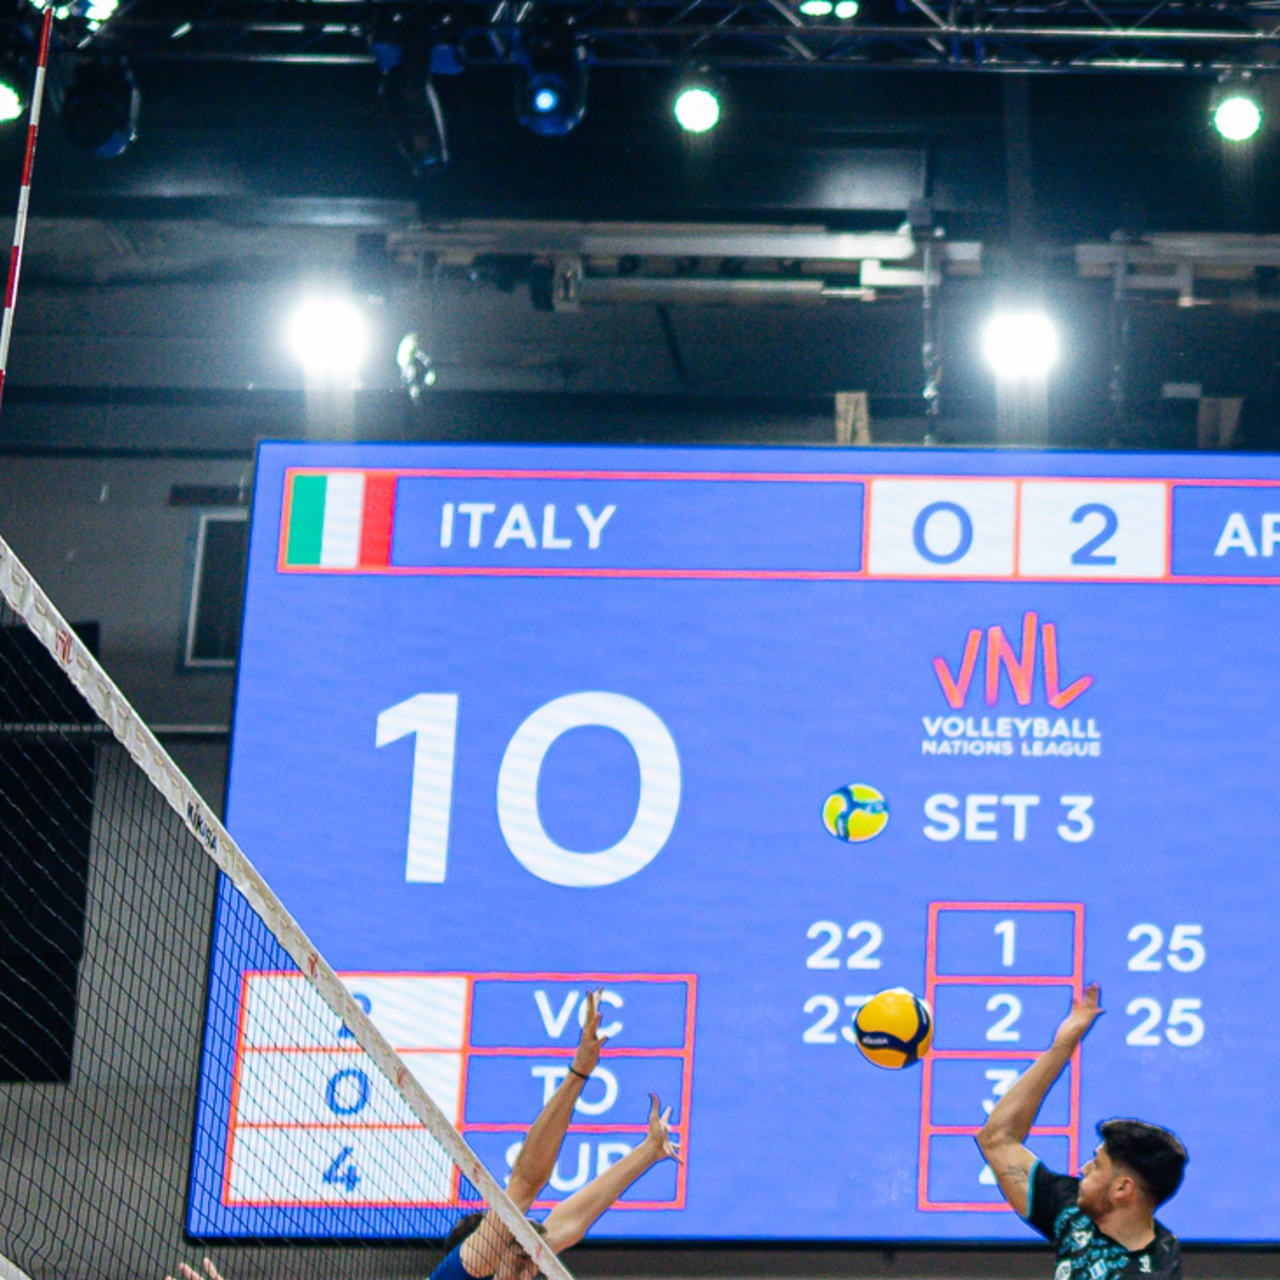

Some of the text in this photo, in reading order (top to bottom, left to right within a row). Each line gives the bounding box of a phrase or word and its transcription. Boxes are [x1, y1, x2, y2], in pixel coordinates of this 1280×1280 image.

[439, 502, 617, 551] ITALY
[911, 501, 975, 565] 0
[1069, 502, 1120, 567] 2
[932, 610, 1095, 710] VNL
[921, 716, 1102, 738] VOLLEYBALL
[921, 740, 1102, 757] NATIONS LEAGUE
[374, 690, 683, 888] 10
[922, 793, 1096, 843] SET 3
[805, 919, 1205, 972] 22 1 25
[534, 989, 625, 1039] VC
[985, 993, 1022, 1042] 2
[1125, 998, 1205, 1047] 25
[324, 1065, 620, 1116] 0 TO
[322, 1145, 362, 1193] 4
